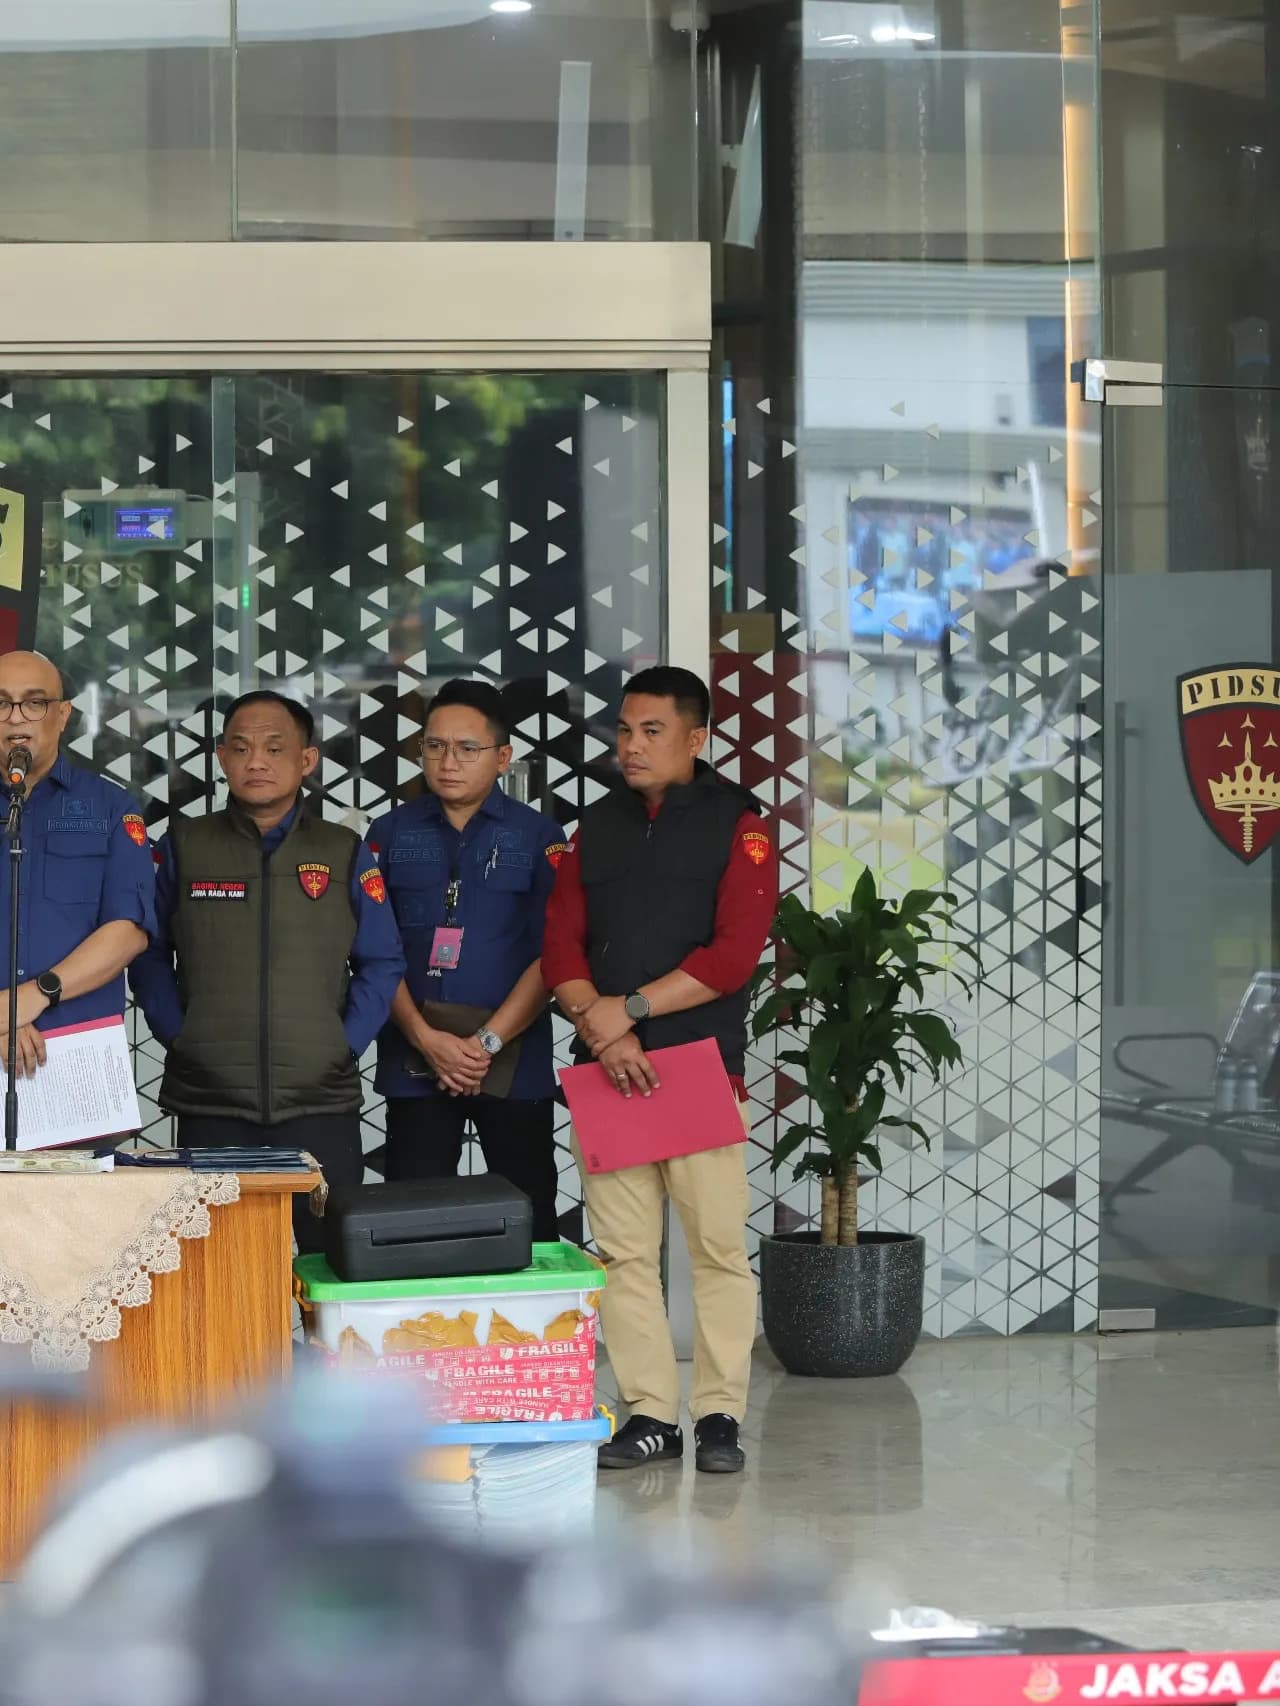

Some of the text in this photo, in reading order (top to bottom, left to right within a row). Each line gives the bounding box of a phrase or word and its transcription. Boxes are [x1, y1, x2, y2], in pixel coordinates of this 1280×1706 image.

[1187, 675, 1280, 705] PIDS
[518, 1342, 589, 1357] FRAGILE
[376, 1354, 425, 1369] AGILE
[475, 1378, 495, 1386] WITH
[498, 1377, 517, 1385] CARE
[1080, 1661, 1246, 1699] JAKSA
